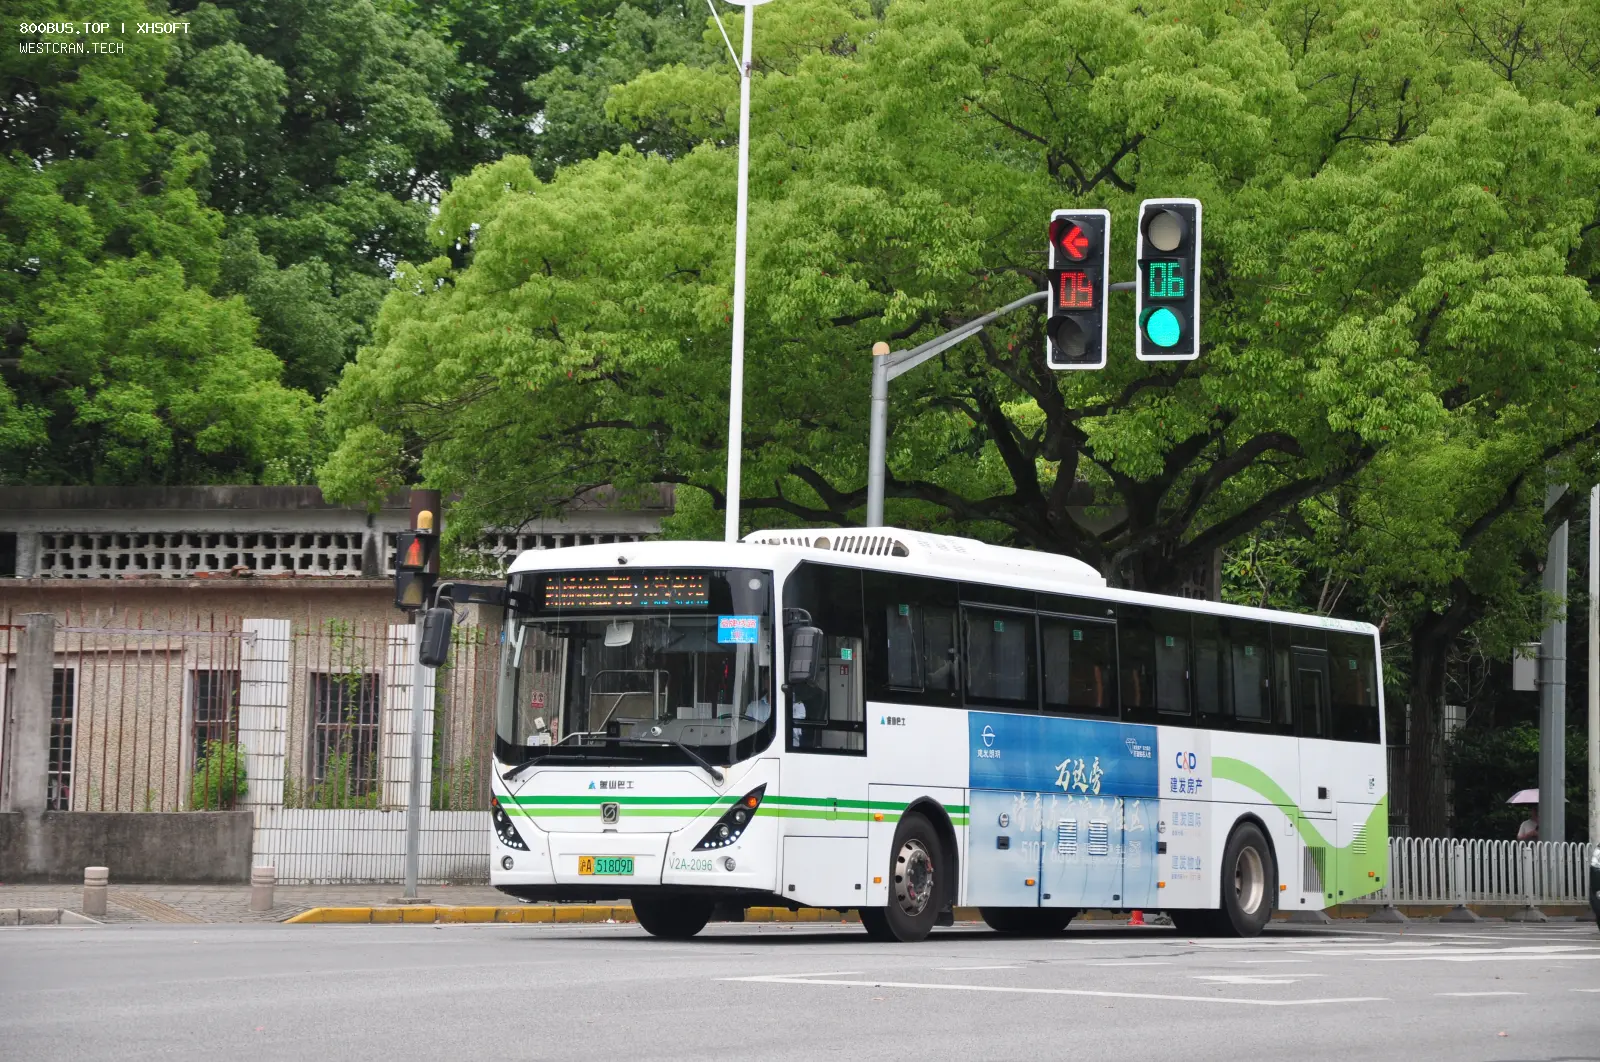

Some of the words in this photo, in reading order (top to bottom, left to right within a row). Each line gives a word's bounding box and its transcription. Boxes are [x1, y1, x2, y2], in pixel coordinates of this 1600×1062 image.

[1149, 262, 1185, 297] 06
[1175, 751, 1197, 774] C&D
[1169, 777, 1203, 795] 建发房产
[597, 859, 633, 873] 51809D
[668, 857, 713, 872] V2A-2096
